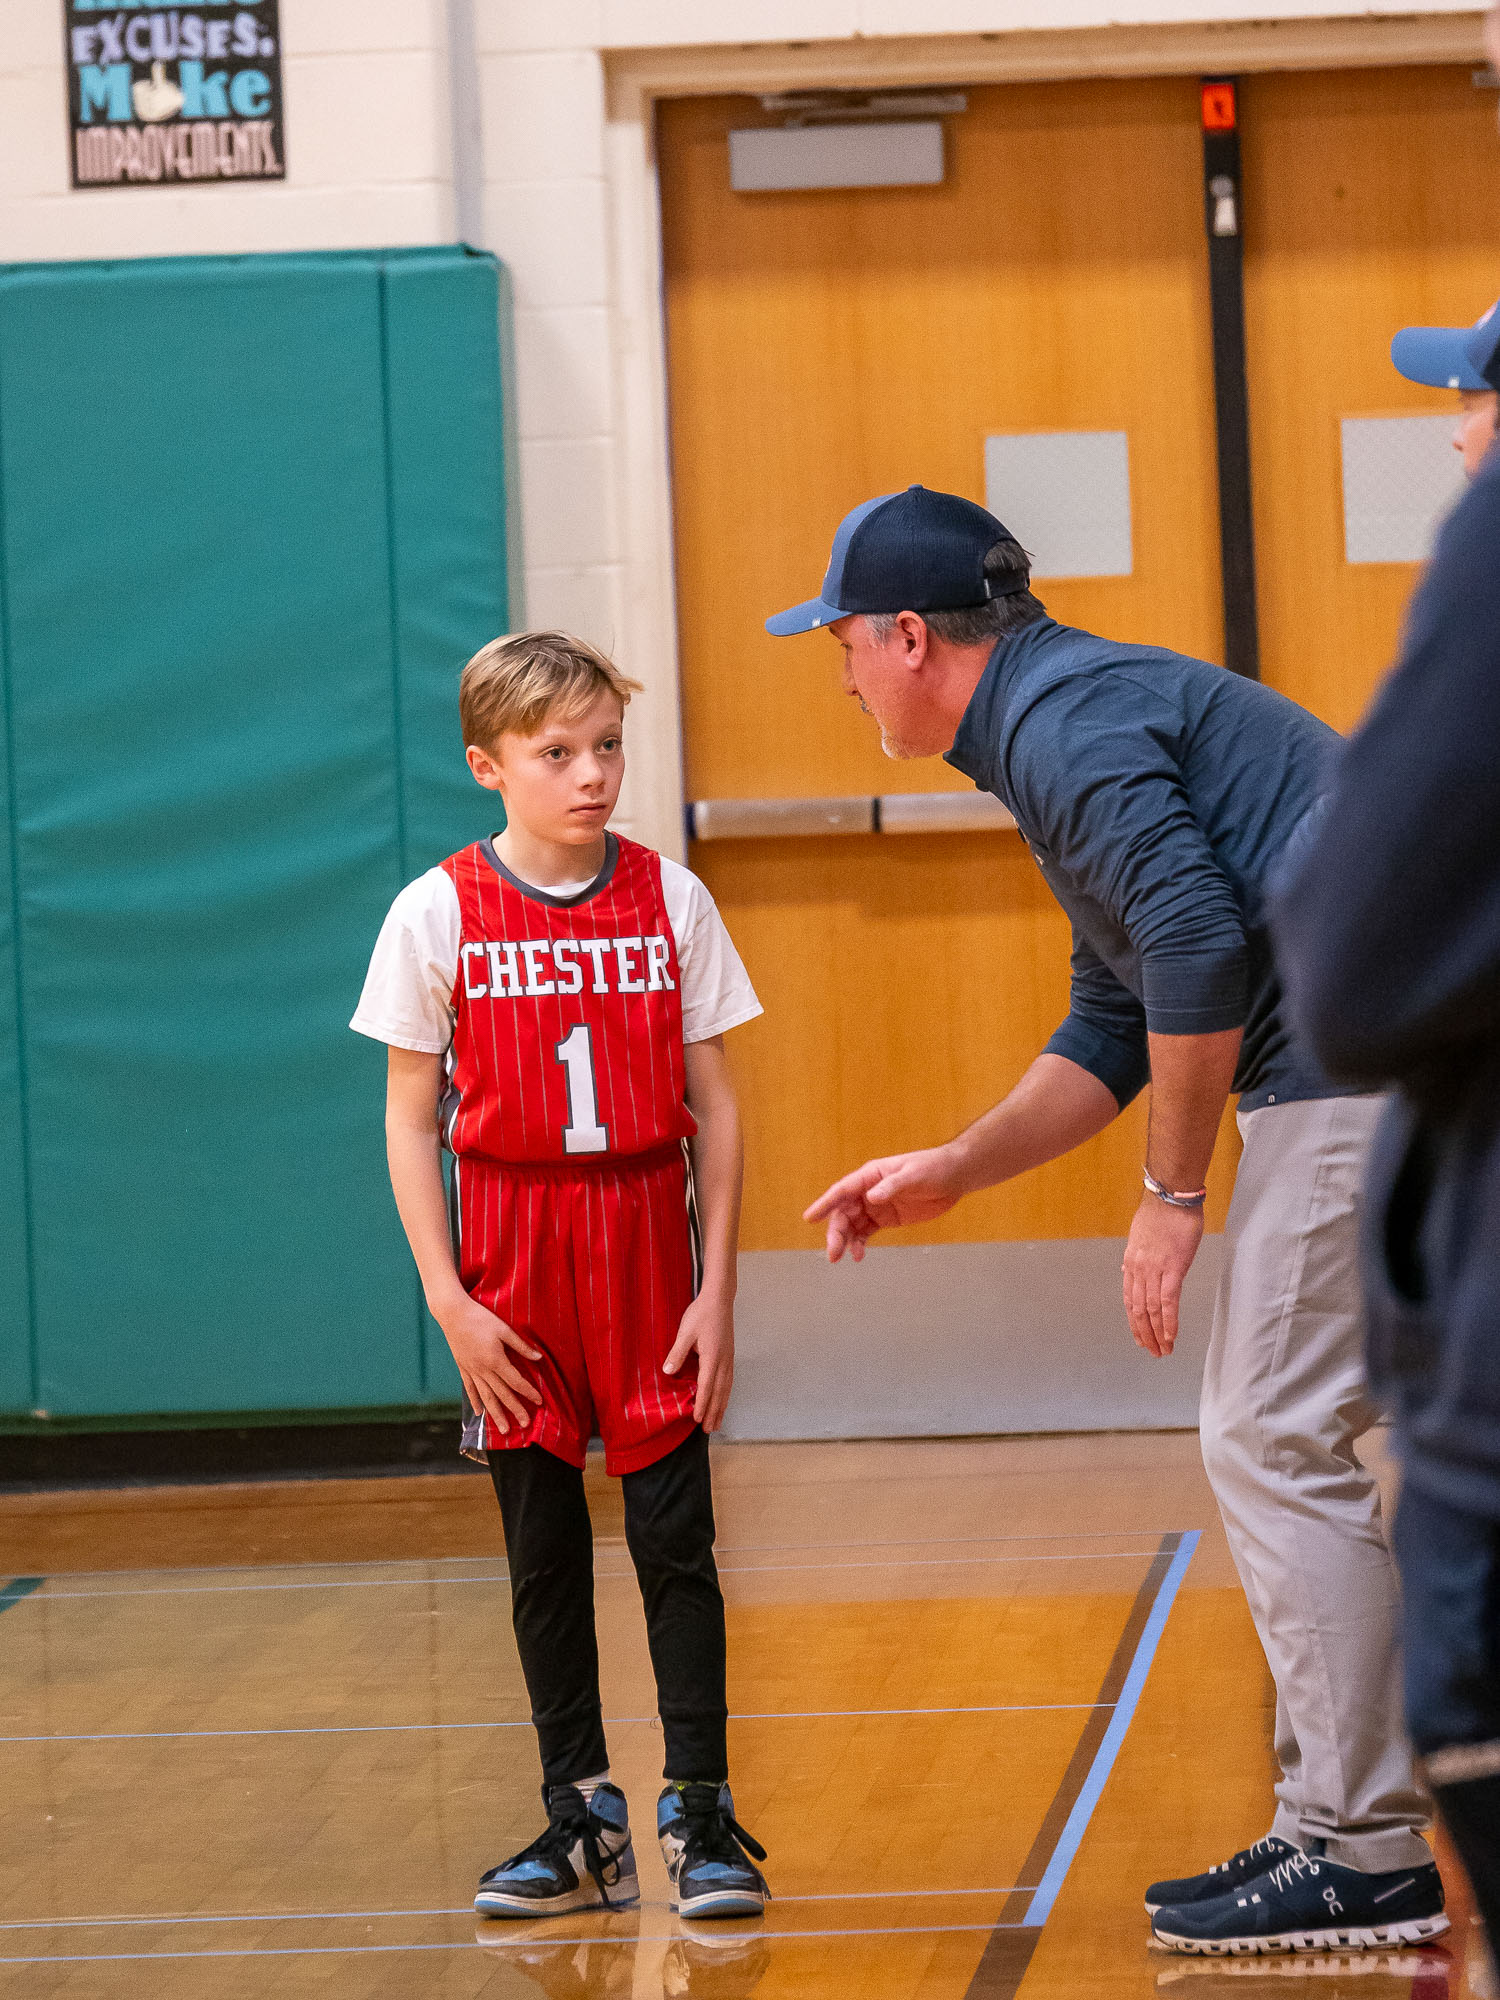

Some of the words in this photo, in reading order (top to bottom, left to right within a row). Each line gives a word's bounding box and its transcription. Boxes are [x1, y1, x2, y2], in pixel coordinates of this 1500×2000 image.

[72, 11, 274, 65] EXCUSES.
[79, 60, 272, 123] Mke
[460, 935, 675, 999] CHESTER
[555, 1023, 609, 1155] 1
